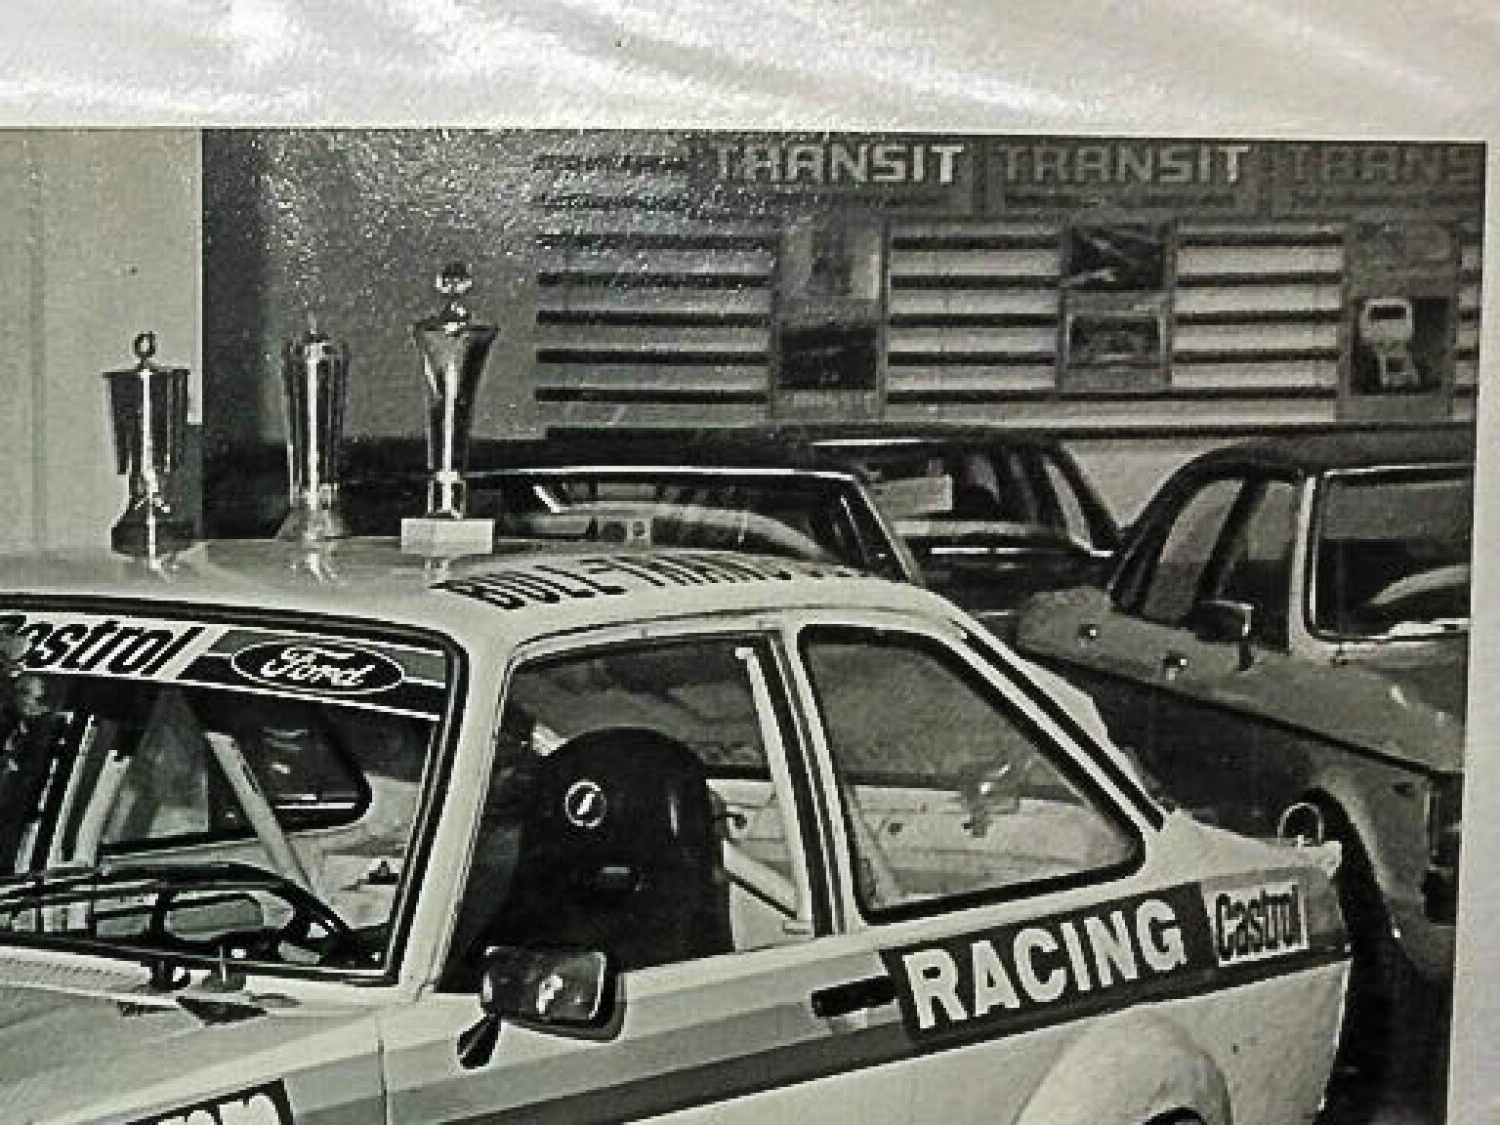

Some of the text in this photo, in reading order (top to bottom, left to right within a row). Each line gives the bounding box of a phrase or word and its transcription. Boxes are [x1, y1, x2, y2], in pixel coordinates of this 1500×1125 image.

[712, 143, 965, 184] TRANSIT
[1000, 144, 1250, 184] TRANSIT
[260, 644, 377, 688] Ford
[1215, 884, 1302, 962] Castrol
[901, 900, 1187, 1031] RACING
